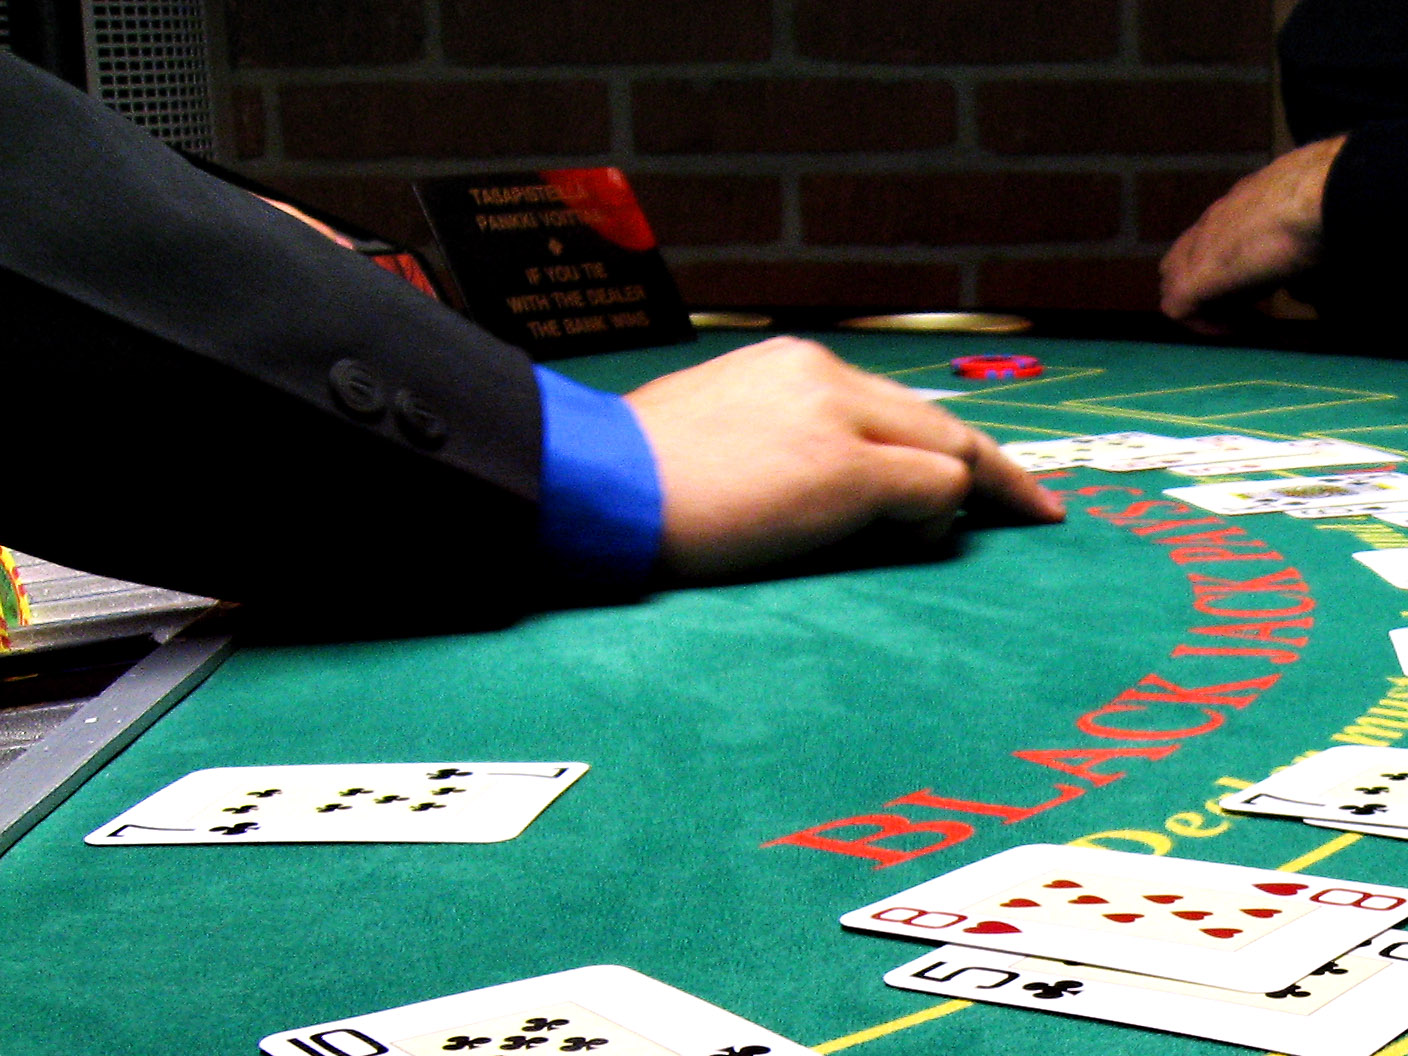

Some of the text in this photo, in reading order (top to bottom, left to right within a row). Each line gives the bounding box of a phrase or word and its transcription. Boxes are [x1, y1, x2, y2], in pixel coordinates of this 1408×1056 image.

[525, 262, 608, 286] IF YOU TIE
[506, 284, 646, 314] WITH THE DEALER
[527, 310, 650, 339] THE BANK WINS
[1086, 498, 1284, 565] PAYS
[1169, 566, 1317, 665] JACK
[759, 672, 1283, 871] BLACK
[1308, 888, 1408, 911] 8
[870, 906, 969, 929] 8
[911, 961, 1021, 990] 5
